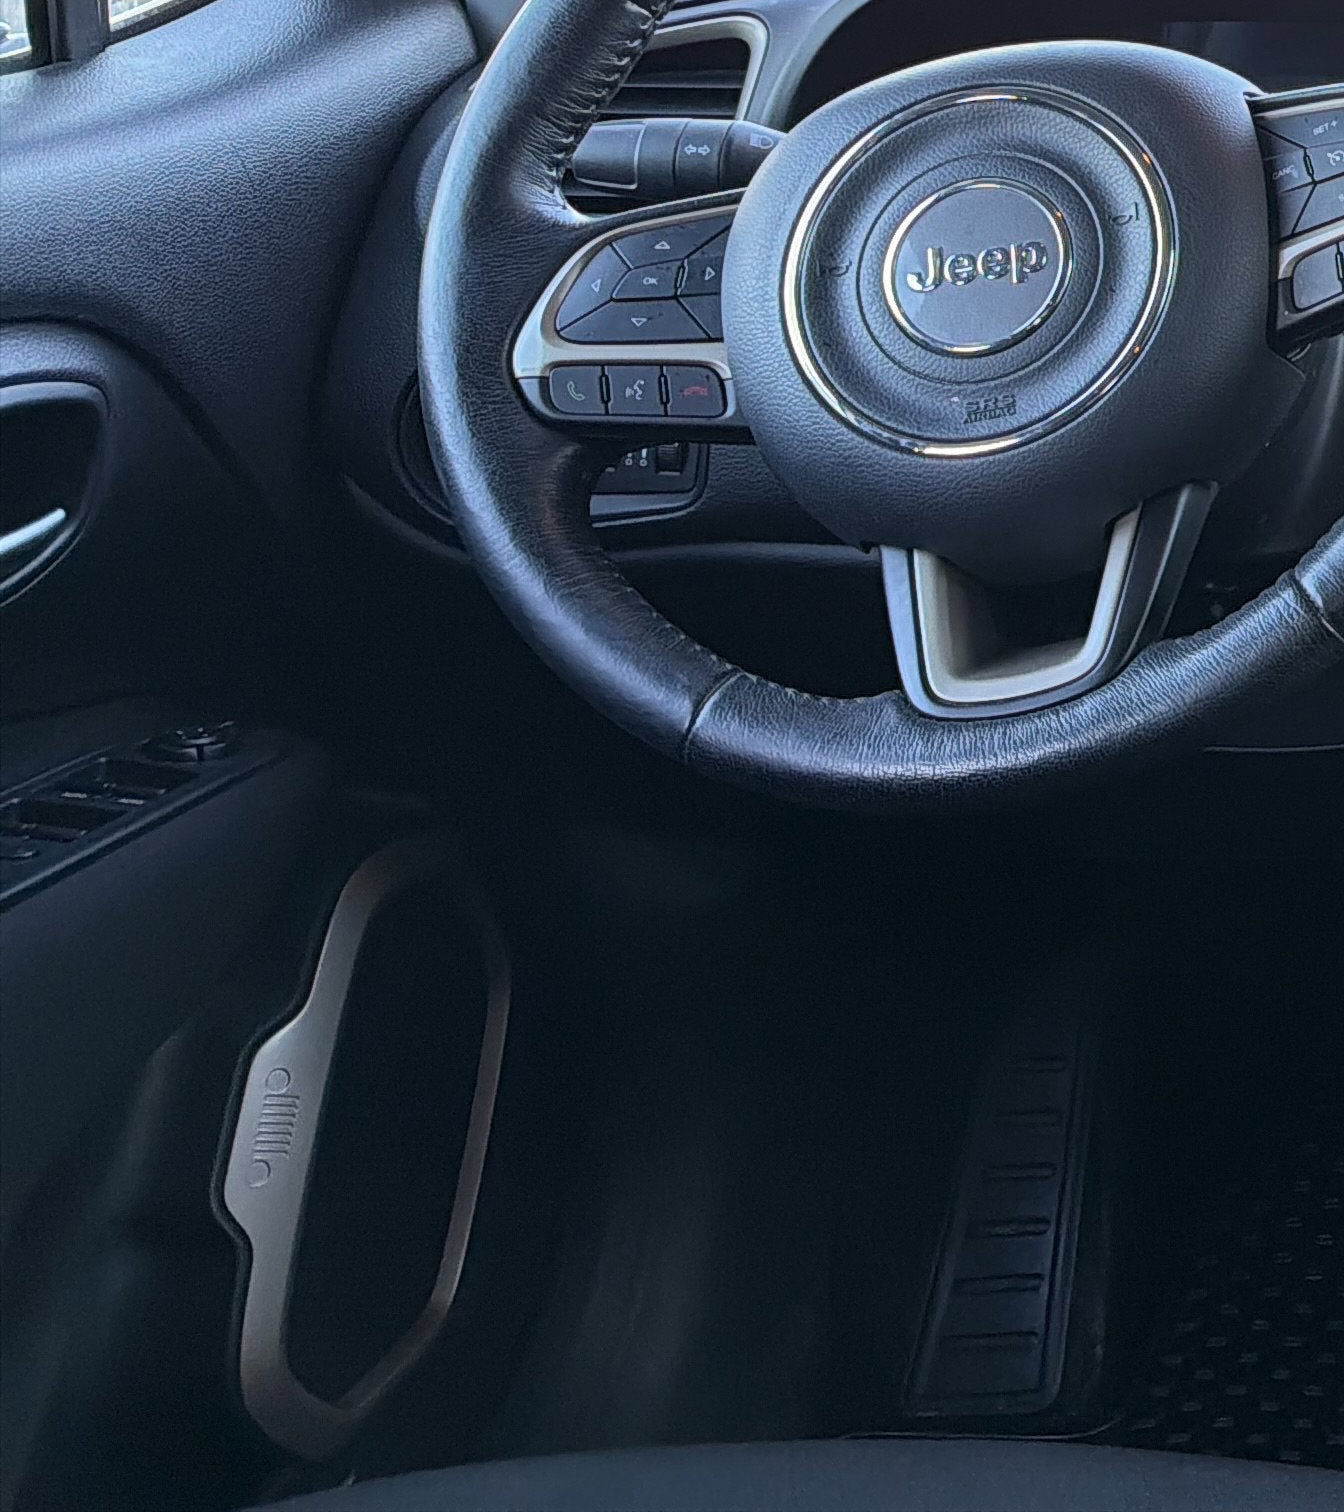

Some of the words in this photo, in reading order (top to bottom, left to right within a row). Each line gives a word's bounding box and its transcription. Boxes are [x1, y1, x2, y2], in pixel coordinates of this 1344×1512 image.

[906, 241, 1048, 293] Jeep
[642, 276, 658, 285] OK
[964, 394, 1017, 412] SRS
